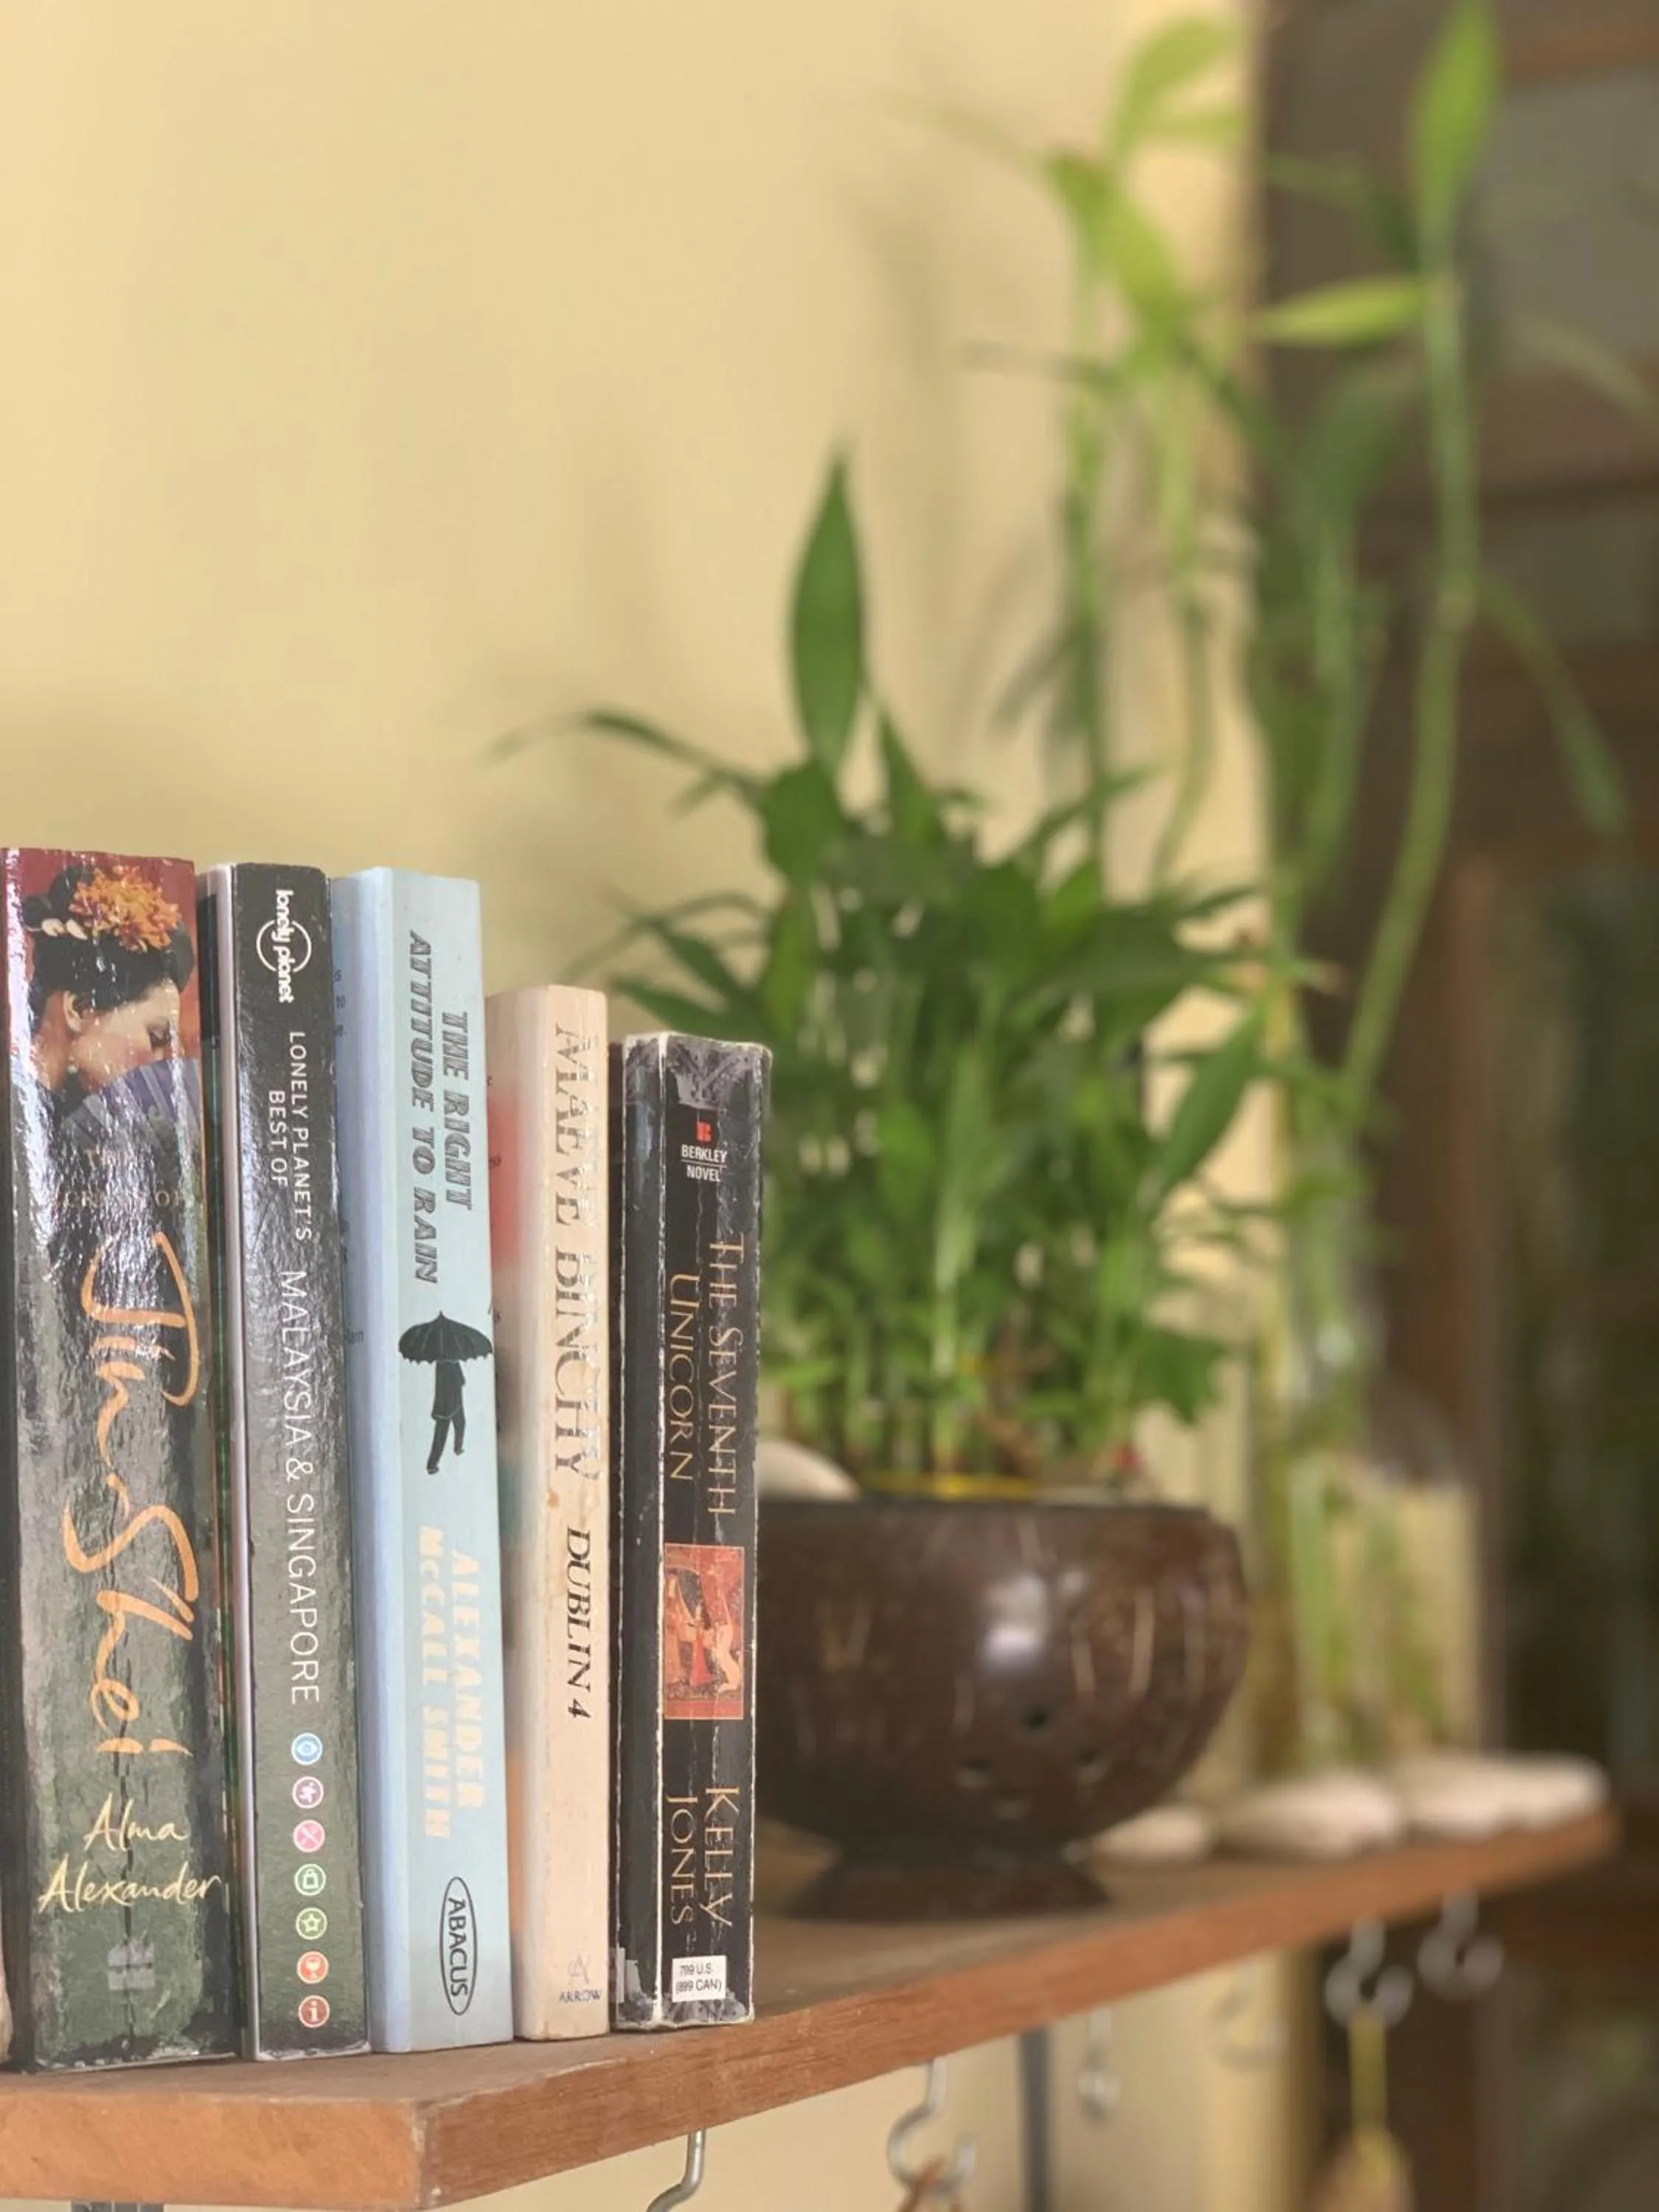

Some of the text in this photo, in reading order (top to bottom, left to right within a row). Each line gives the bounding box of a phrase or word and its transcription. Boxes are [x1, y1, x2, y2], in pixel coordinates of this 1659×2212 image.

[271, 889, 296, 1004] lonely planet
[269, 1091, 288, 1187] BEST OF
[289, 1032, 313, 1240] LONELY PLANET'S
[410, 929, 438, 1284] ATTITUDE TO RAIN
[442, 1011, 472, 1211] THE RIGHT
[681, 1144, 728, 1164] BERKLEY
[686, 1165, 721, 1181] NOVEL
[669, 1273, 700, 1481] UNICORN
[708, 1232, 745, 1514] THE SEVENTH
[279, 1270, 319, 1705] MALAYSIA & SINGAPORE
[451, 1548, 484, 1808] ALEXANDER
[566, 1527, 591, 1719] DUBLIN 4
[83, 1792, 189, 1851] Alma
[422, 1705, 451, 1838] SMITH
[38, 1852, 222, 1914] Alexander
[666, 1795, 698, 1926] JONES
[699, 1787, 740, 1927] KELLY
[448, 1897, 467, 1997] ABACUS
[559, 1989, 602, 2003] ARROW
